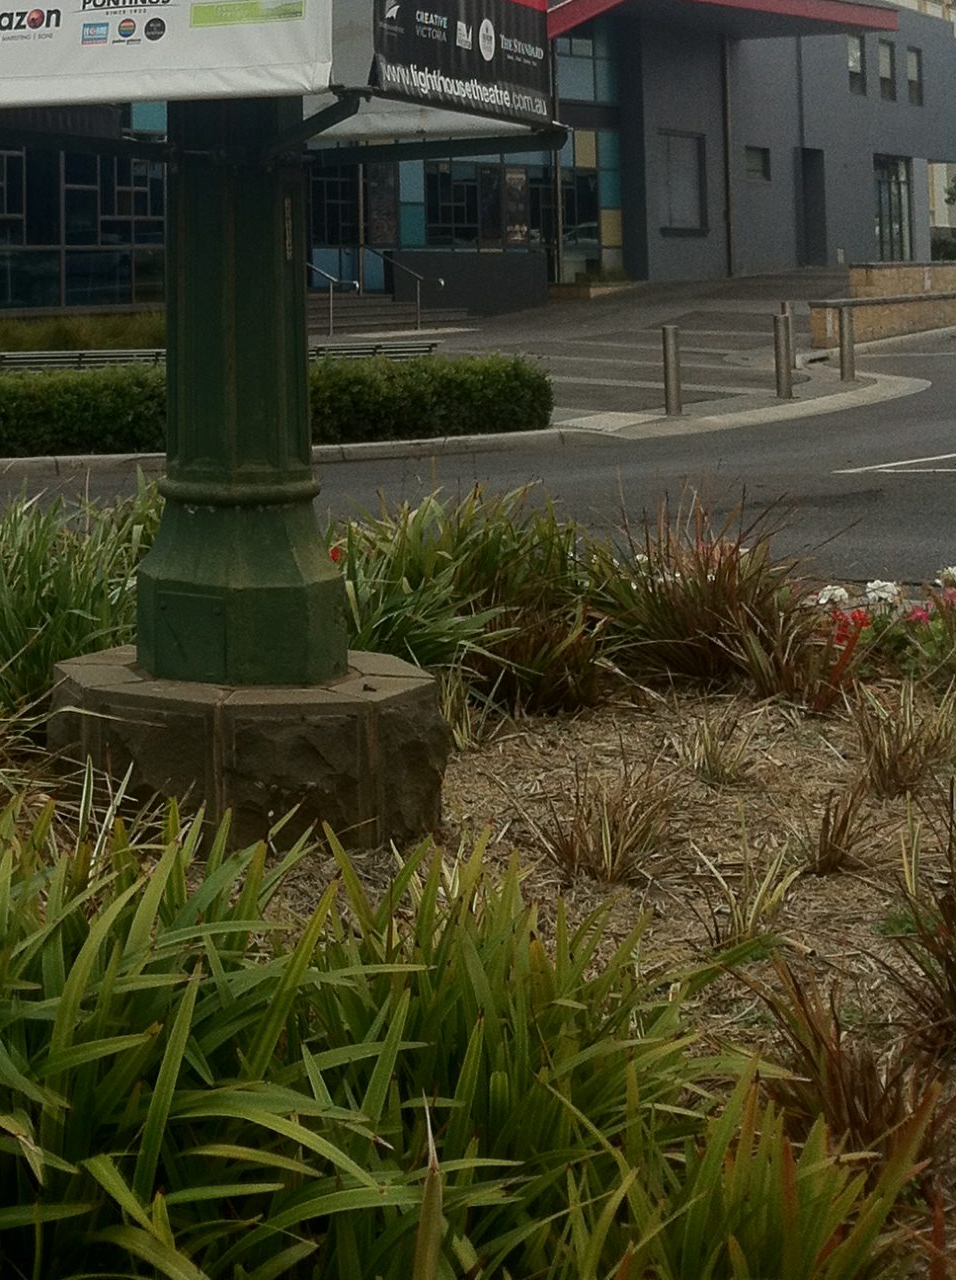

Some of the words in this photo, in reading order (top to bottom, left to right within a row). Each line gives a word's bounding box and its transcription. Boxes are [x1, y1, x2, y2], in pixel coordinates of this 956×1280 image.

[416, 10, 448, 29] CREATIVE
[416, 24, 448, 41] VICTORIA
[380, 62, 547, 115] www.lighthousetheatre.com.au
